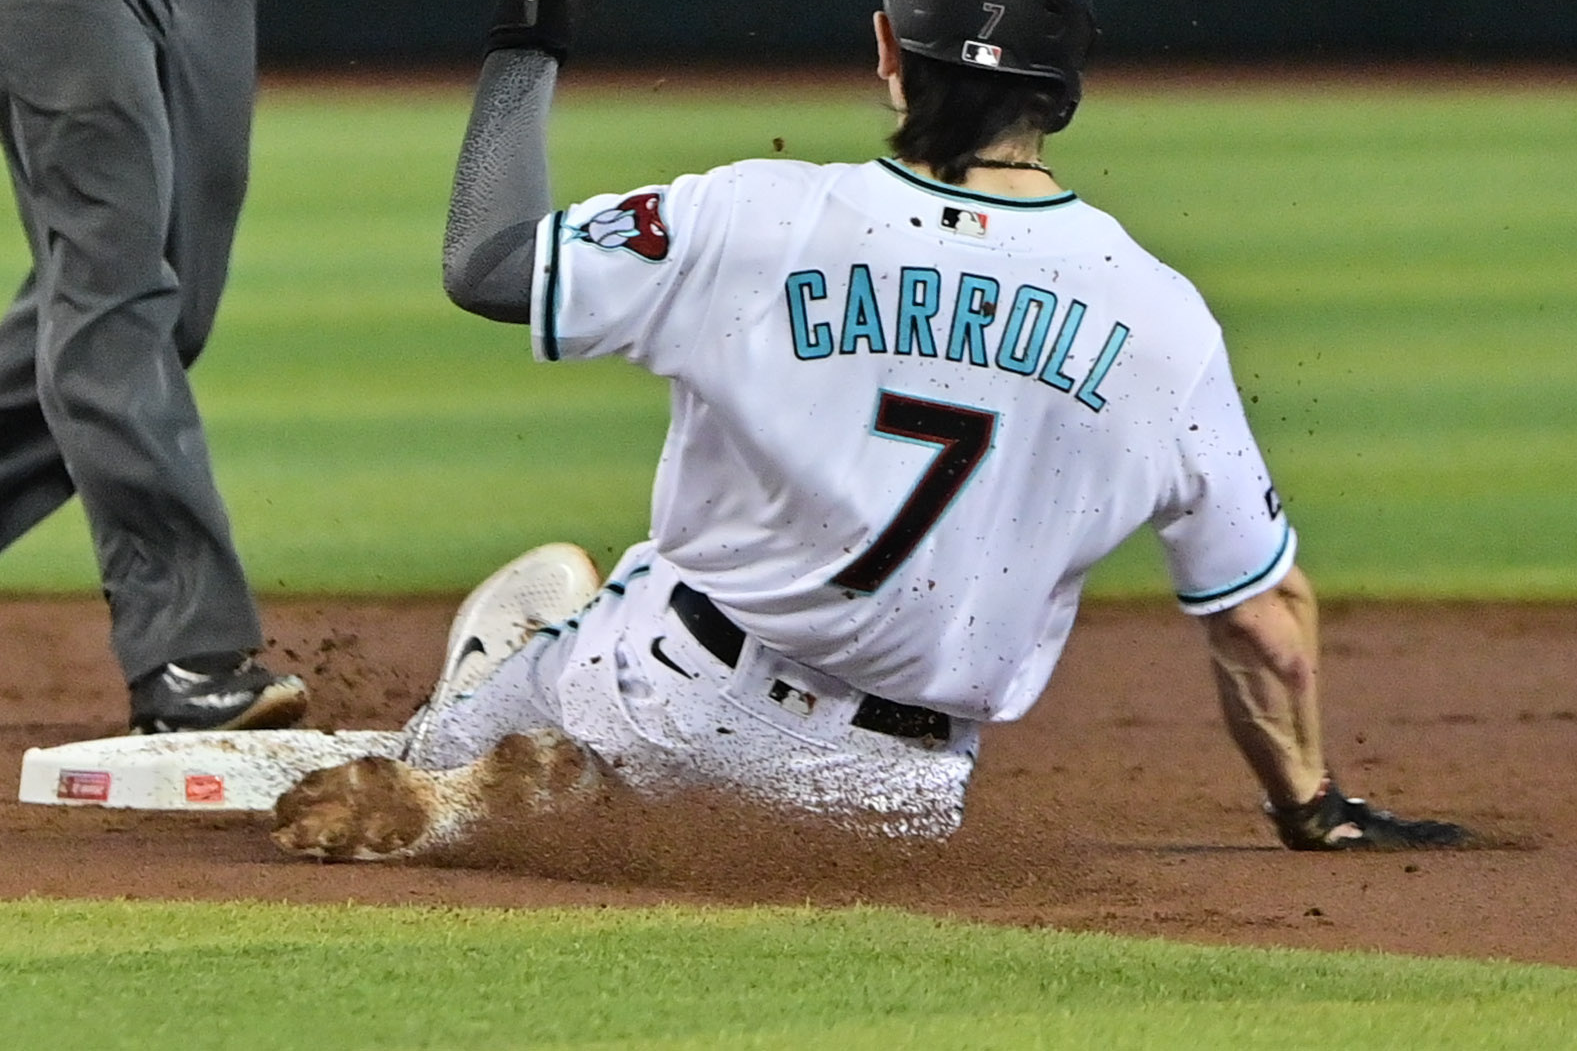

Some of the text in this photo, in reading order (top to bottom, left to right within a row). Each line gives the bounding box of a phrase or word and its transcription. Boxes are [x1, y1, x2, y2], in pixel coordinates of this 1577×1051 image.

[977, 2, 1005, 40] 7
[784, 264, 1131, 414] CARROLL
[828, 386, 1000, 596] 7
